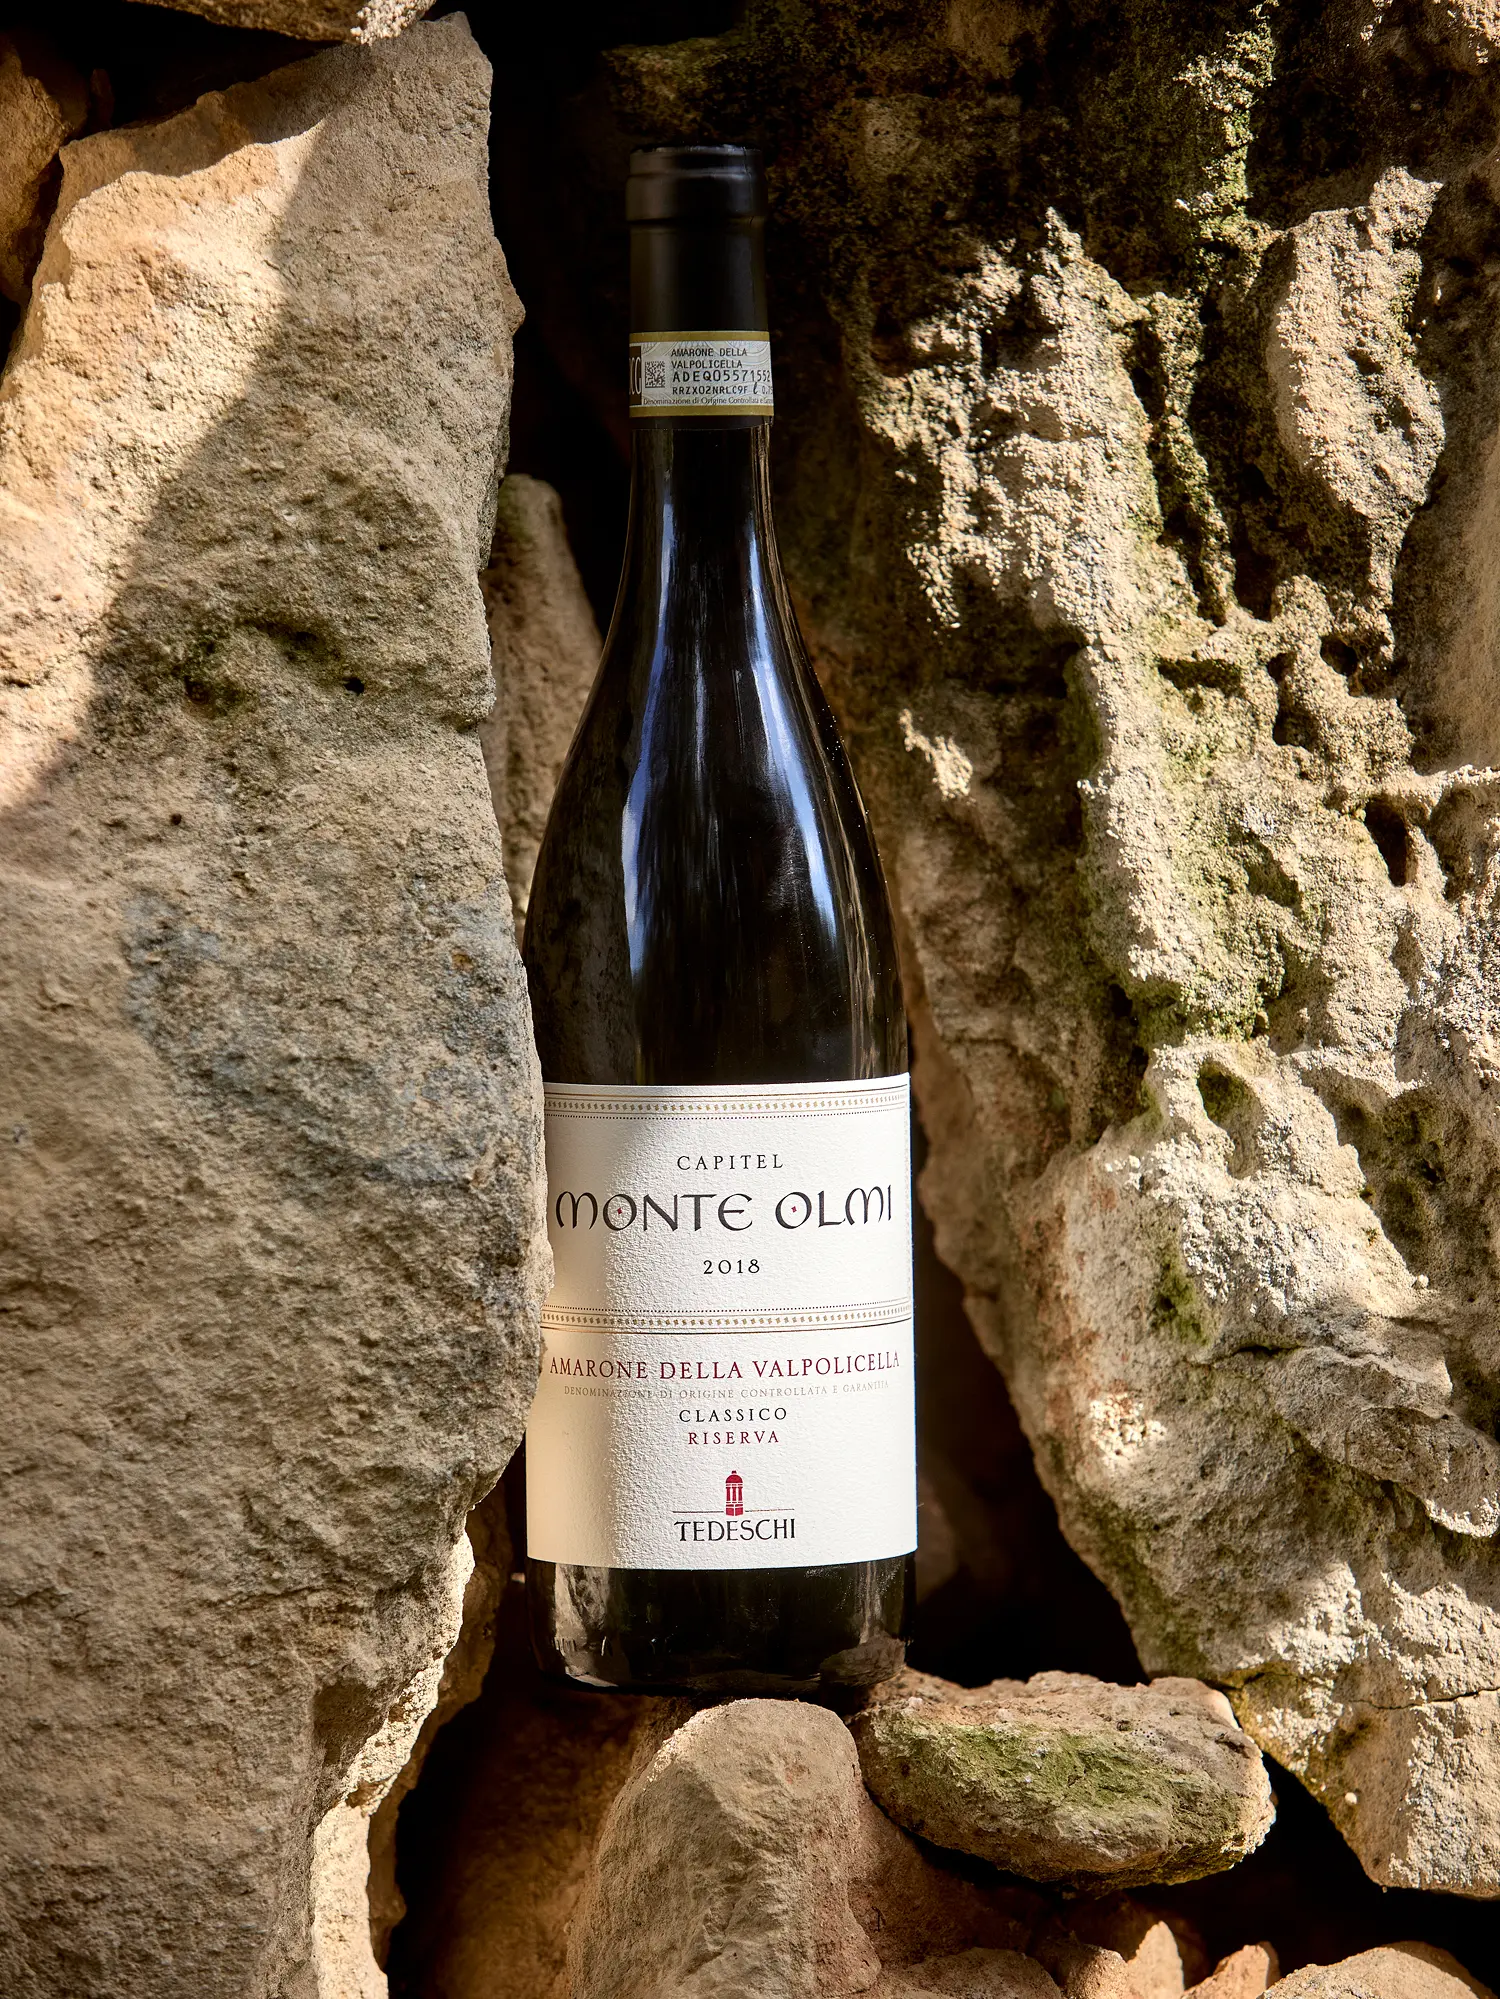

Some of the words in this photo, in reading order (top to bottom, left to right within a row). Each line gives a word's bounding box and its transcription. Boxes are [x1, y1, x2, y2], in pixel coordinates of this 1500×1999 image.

[671, 348, 713, 357] AMARONE
[719, 347, 748, 357] DELLA
[671, 359, 742, 369] VALPOLICELLA
[629, 356, 642, 395] CG
[644, 397, 691, 405] Denominazione
[701, 396, 727, 406] Origine
[677, 1154, 784, 1171] CAPITEL
[555, 1190, 753, 1232] MONTE
[775, 1184, 892, 1230] OLMI
[703, 1258, 761, 1275] 2018
[549, 1356, 648, 1380] AMARONE
[659, 1360, 744, 1380] DELLA
[752, 1351, 900, 1379] VALPOLICELLA
[564, 1385, 651, 1399] DENOMINAZIONE
[660, 1390, 673, 1399] DI
[679, 1389, 734, 1400] ORIGINE
[740, 1386, 828, 1399] CONTROLLATA
[833, 1385, 838, 1394] E
[842, 1380, 890, 1393] GARANTITA
[679, 1406, 787, 1423] CLASSICO
[688, 1430, 779, 1445] RISERVA
[673, 1518, 796, 1542] TEDESCHI
